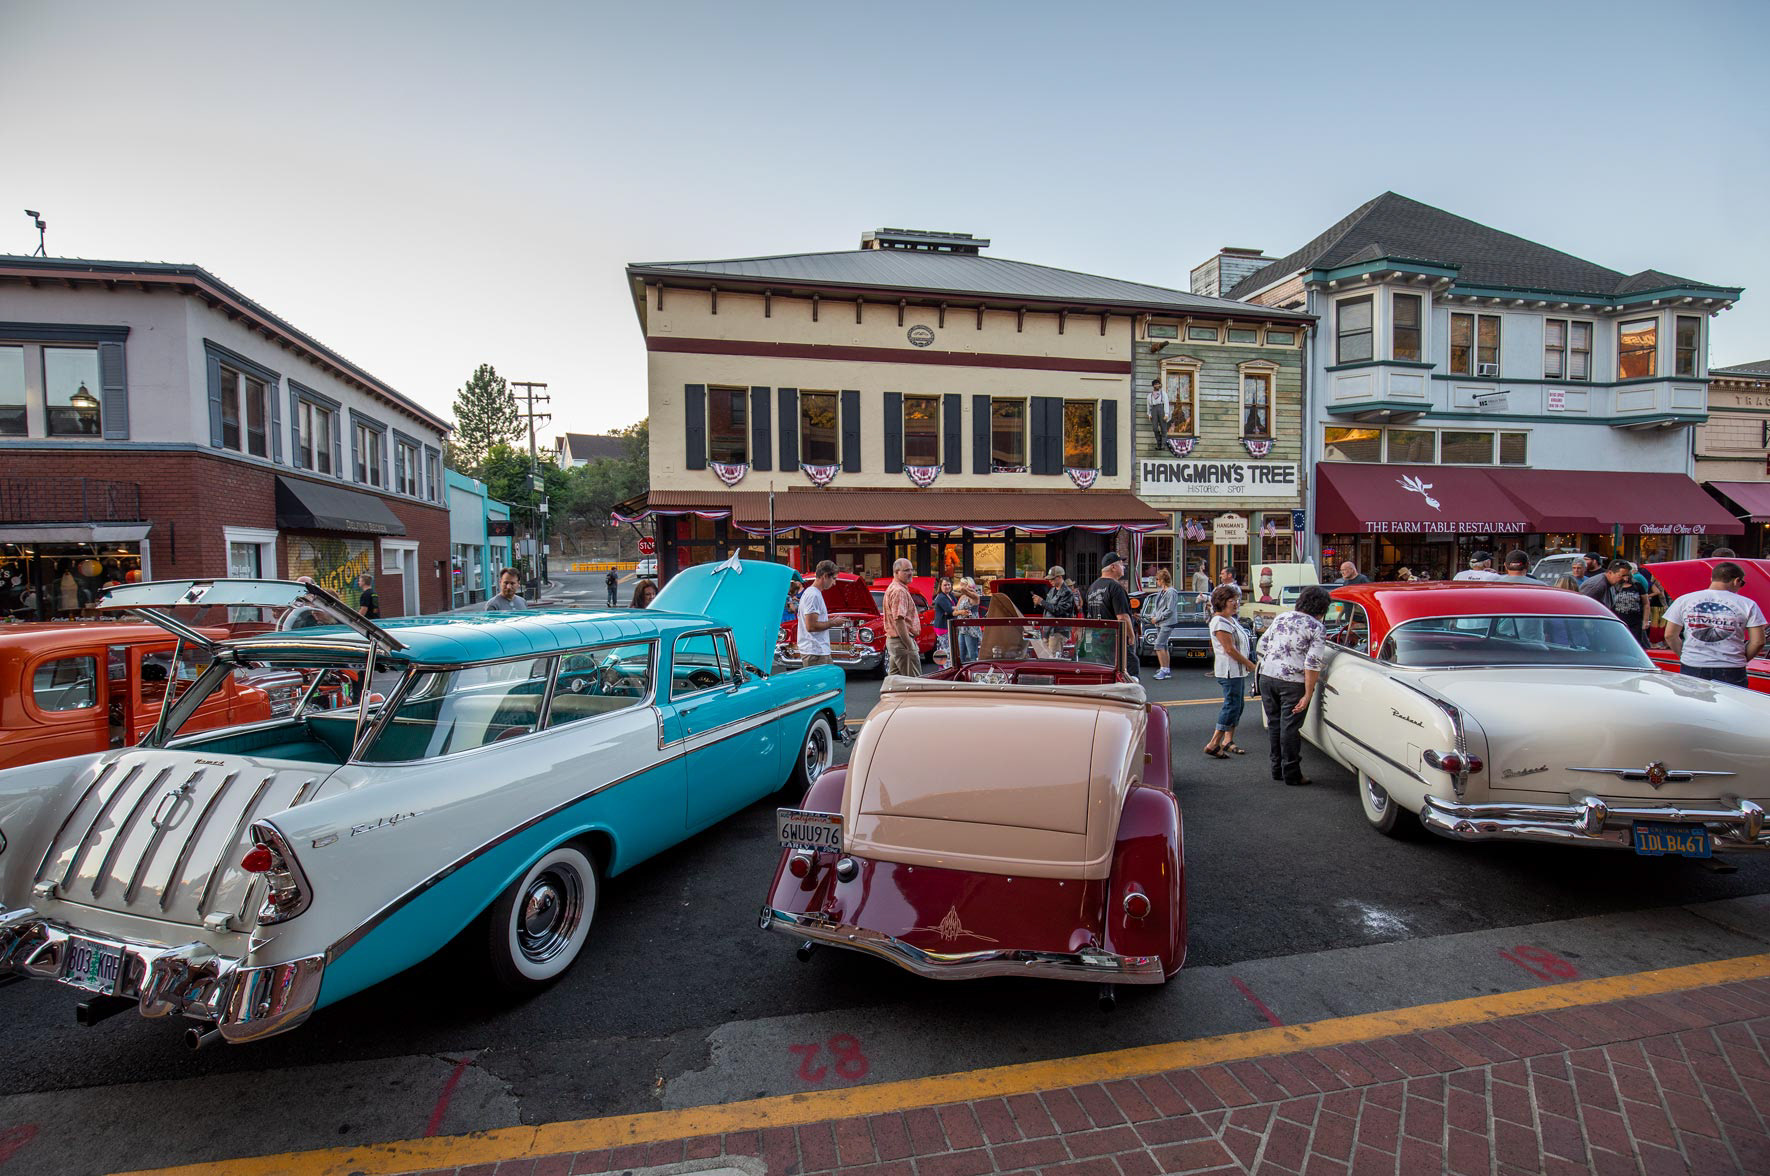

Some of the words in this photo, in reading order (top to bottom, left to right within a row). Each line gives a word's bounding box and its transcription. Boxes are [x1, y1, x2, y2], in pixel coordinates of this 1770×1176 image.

[1143, 463, 1244, 483] HANGMAN'S
[1247, 465, 1295, 483] TREE
[1187, 484, 1219, 494] HISTORIC
[1227, 485, 1245, 494] SPOT
[1366, 522, 1389, 533] THE
[1391, 522, 1421, 533] FARM
[1423, 522, 1457, 533] TABLE
[1458, 522, 1526, 533] RESTAURANT
[1391, 707, 1424, 728] Packard
[782, 823, 839, 845] 6WUU976
[1640, 834, 1704, 853] 1DLB467
[69, 946, 92, 974] 803
